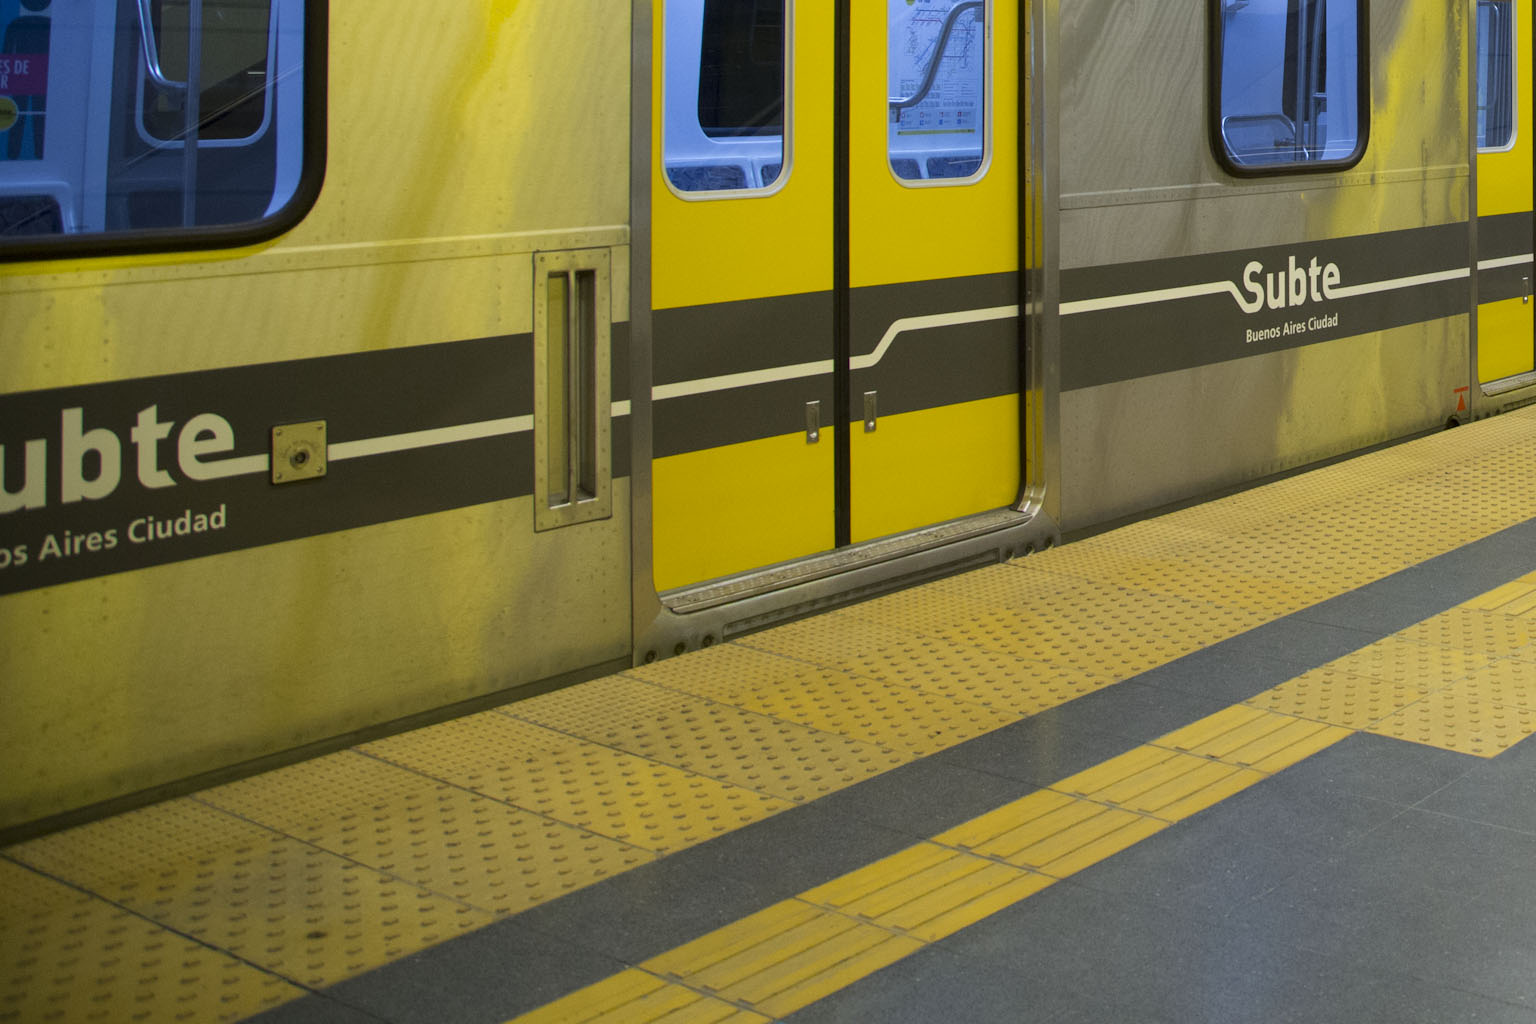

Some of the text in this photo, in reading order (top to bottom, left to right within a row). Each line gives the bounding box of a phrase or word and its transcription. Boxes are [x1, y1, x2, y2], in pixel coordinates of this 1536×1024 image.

[15, 59, 29, 75] DE
[1242, 255, 1341, 314] Subte
[1246, 312, 1339, 344] Buenos Aires Ciudad
[38, 528, 119, 562] Aires
[127, 503, 227, 544] Ciudad
